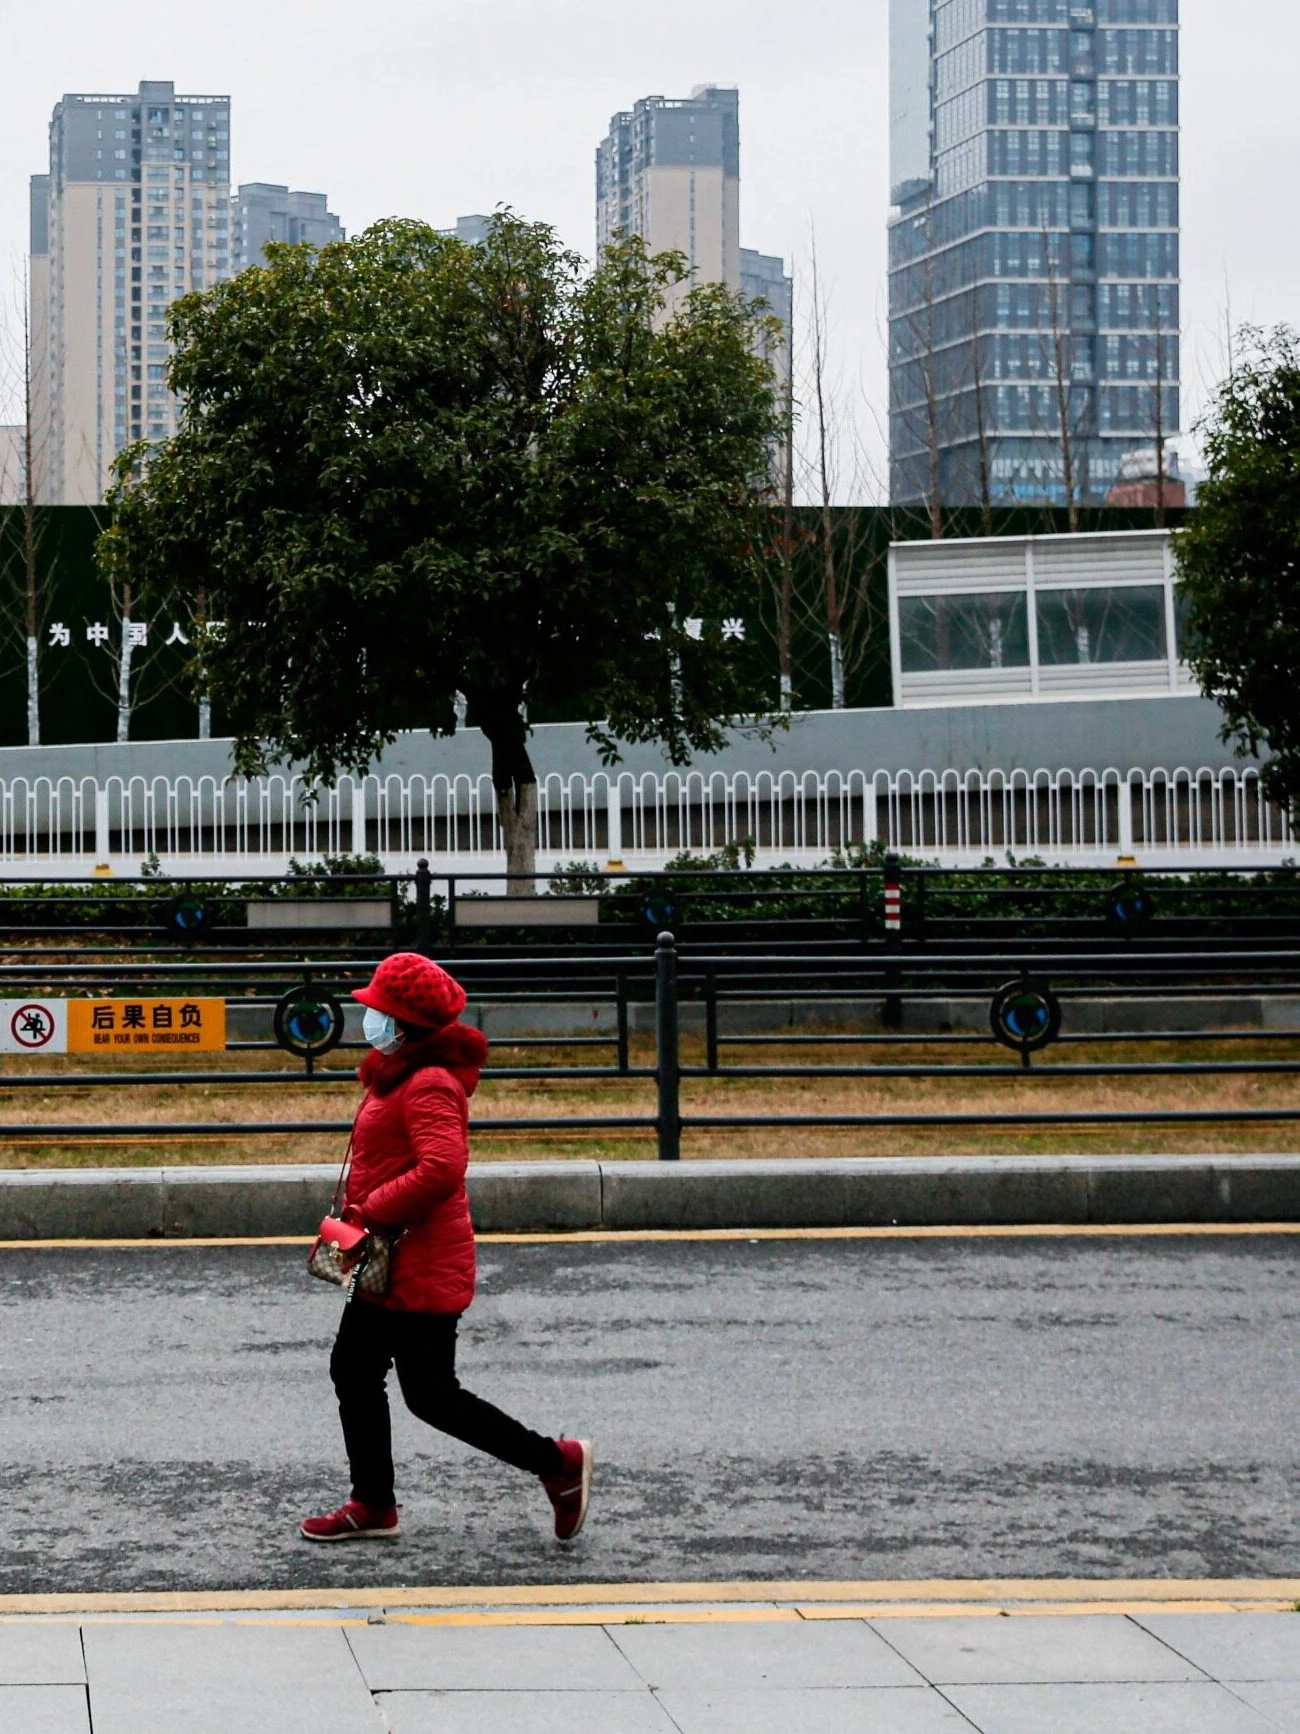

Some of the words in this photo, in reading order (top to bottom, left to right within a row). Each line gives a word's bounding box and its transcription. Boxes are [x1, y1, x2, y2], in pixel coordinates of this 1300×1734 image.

[91, 1003, 202, 1029] 后果自负
[113, 1033, 131, 1045] YOUR
[133, 1033, 149, 1044] OWN
